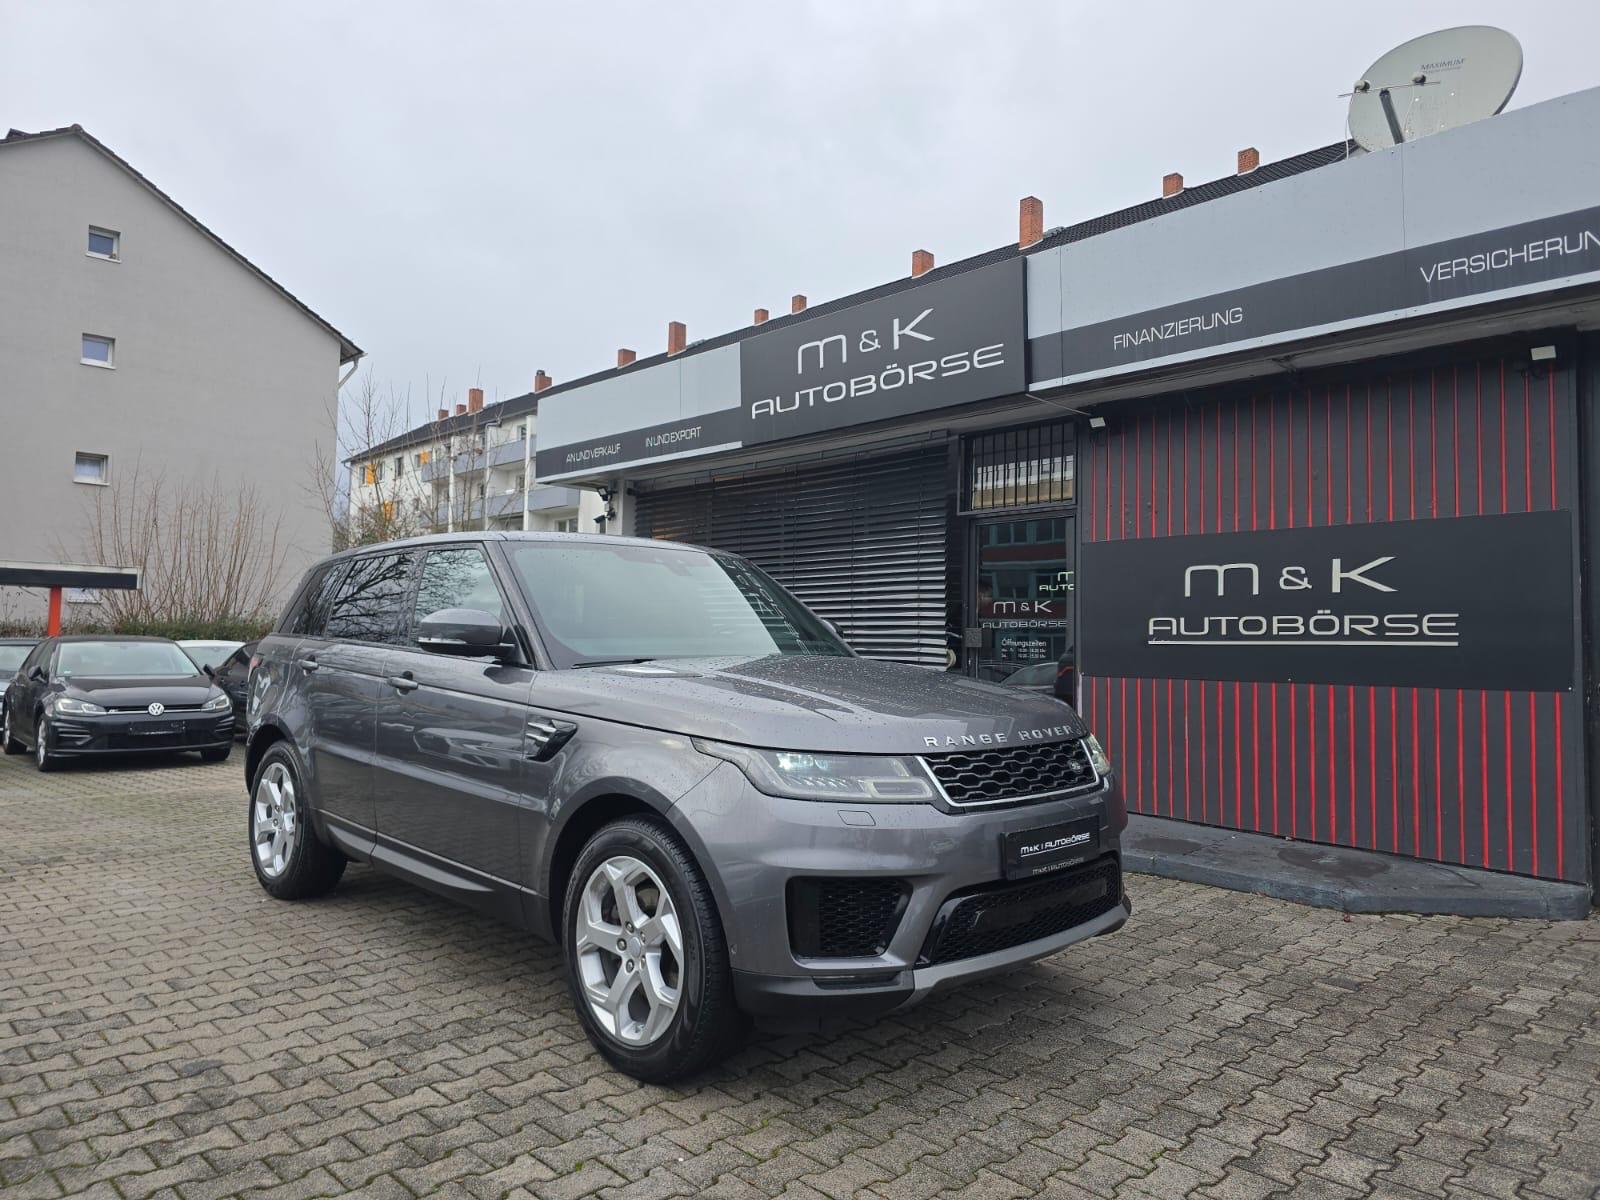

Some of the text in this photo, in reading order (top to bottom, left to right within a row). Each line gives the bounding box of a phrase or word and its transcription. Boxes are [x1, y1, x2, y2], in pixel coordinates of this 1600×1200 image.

[1420, 58, 1464, 70] MAXIMUM
[1419, 230, 1600, 283] VERSICHERUN
[797, 308, 935, 374] M & K
[1113, 306, 1244, 350] FINANZIERUNG
[751, 343, 1005, 419] AUTOBÖRSE
[1184, 556, 1398, 597] M & K
[993, 600, 1053, 614] M & K
[982, 620, 1067, 629] AUTOBÖRSE
[1148, 609, 1460, 636] AUTOBÖRSE
[923, 725, 1075, 747] RANGE ROVER
[1044, 832, 1090, 849] AUTOBÖRSE
